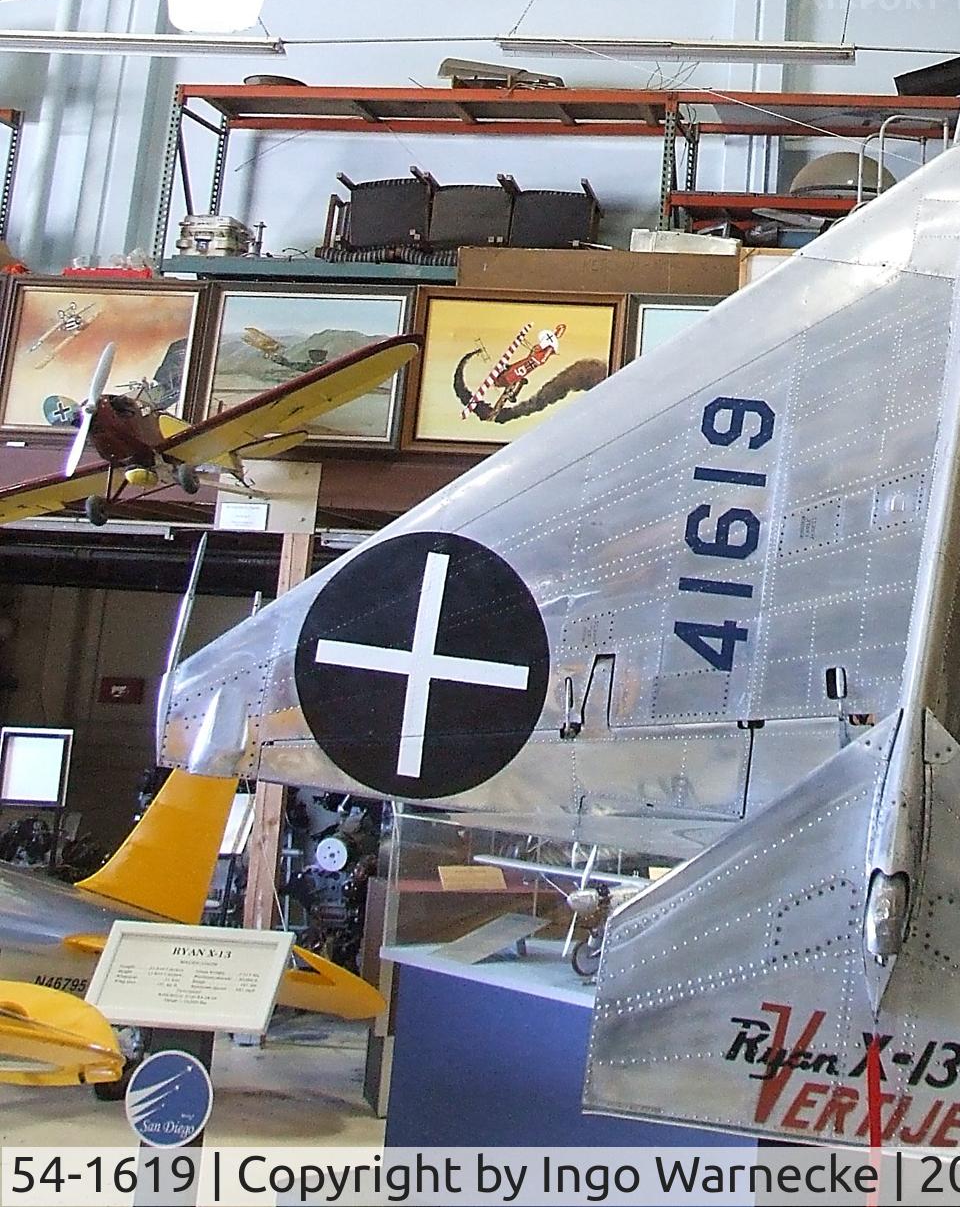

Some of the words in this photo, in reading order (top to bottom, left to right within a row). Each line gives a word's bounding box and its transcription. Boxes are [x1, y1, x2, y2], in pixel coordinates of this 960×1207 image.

[674, 395, 776, 673] 41619
[172, 945, 205, 958] RYAN
[207, 947, 233, 959] X-13
[724, 1017, 840, 1081] Ryan
[140, 1119, 161, 1133] San
[162, 1119, 195, 1138] Diego
